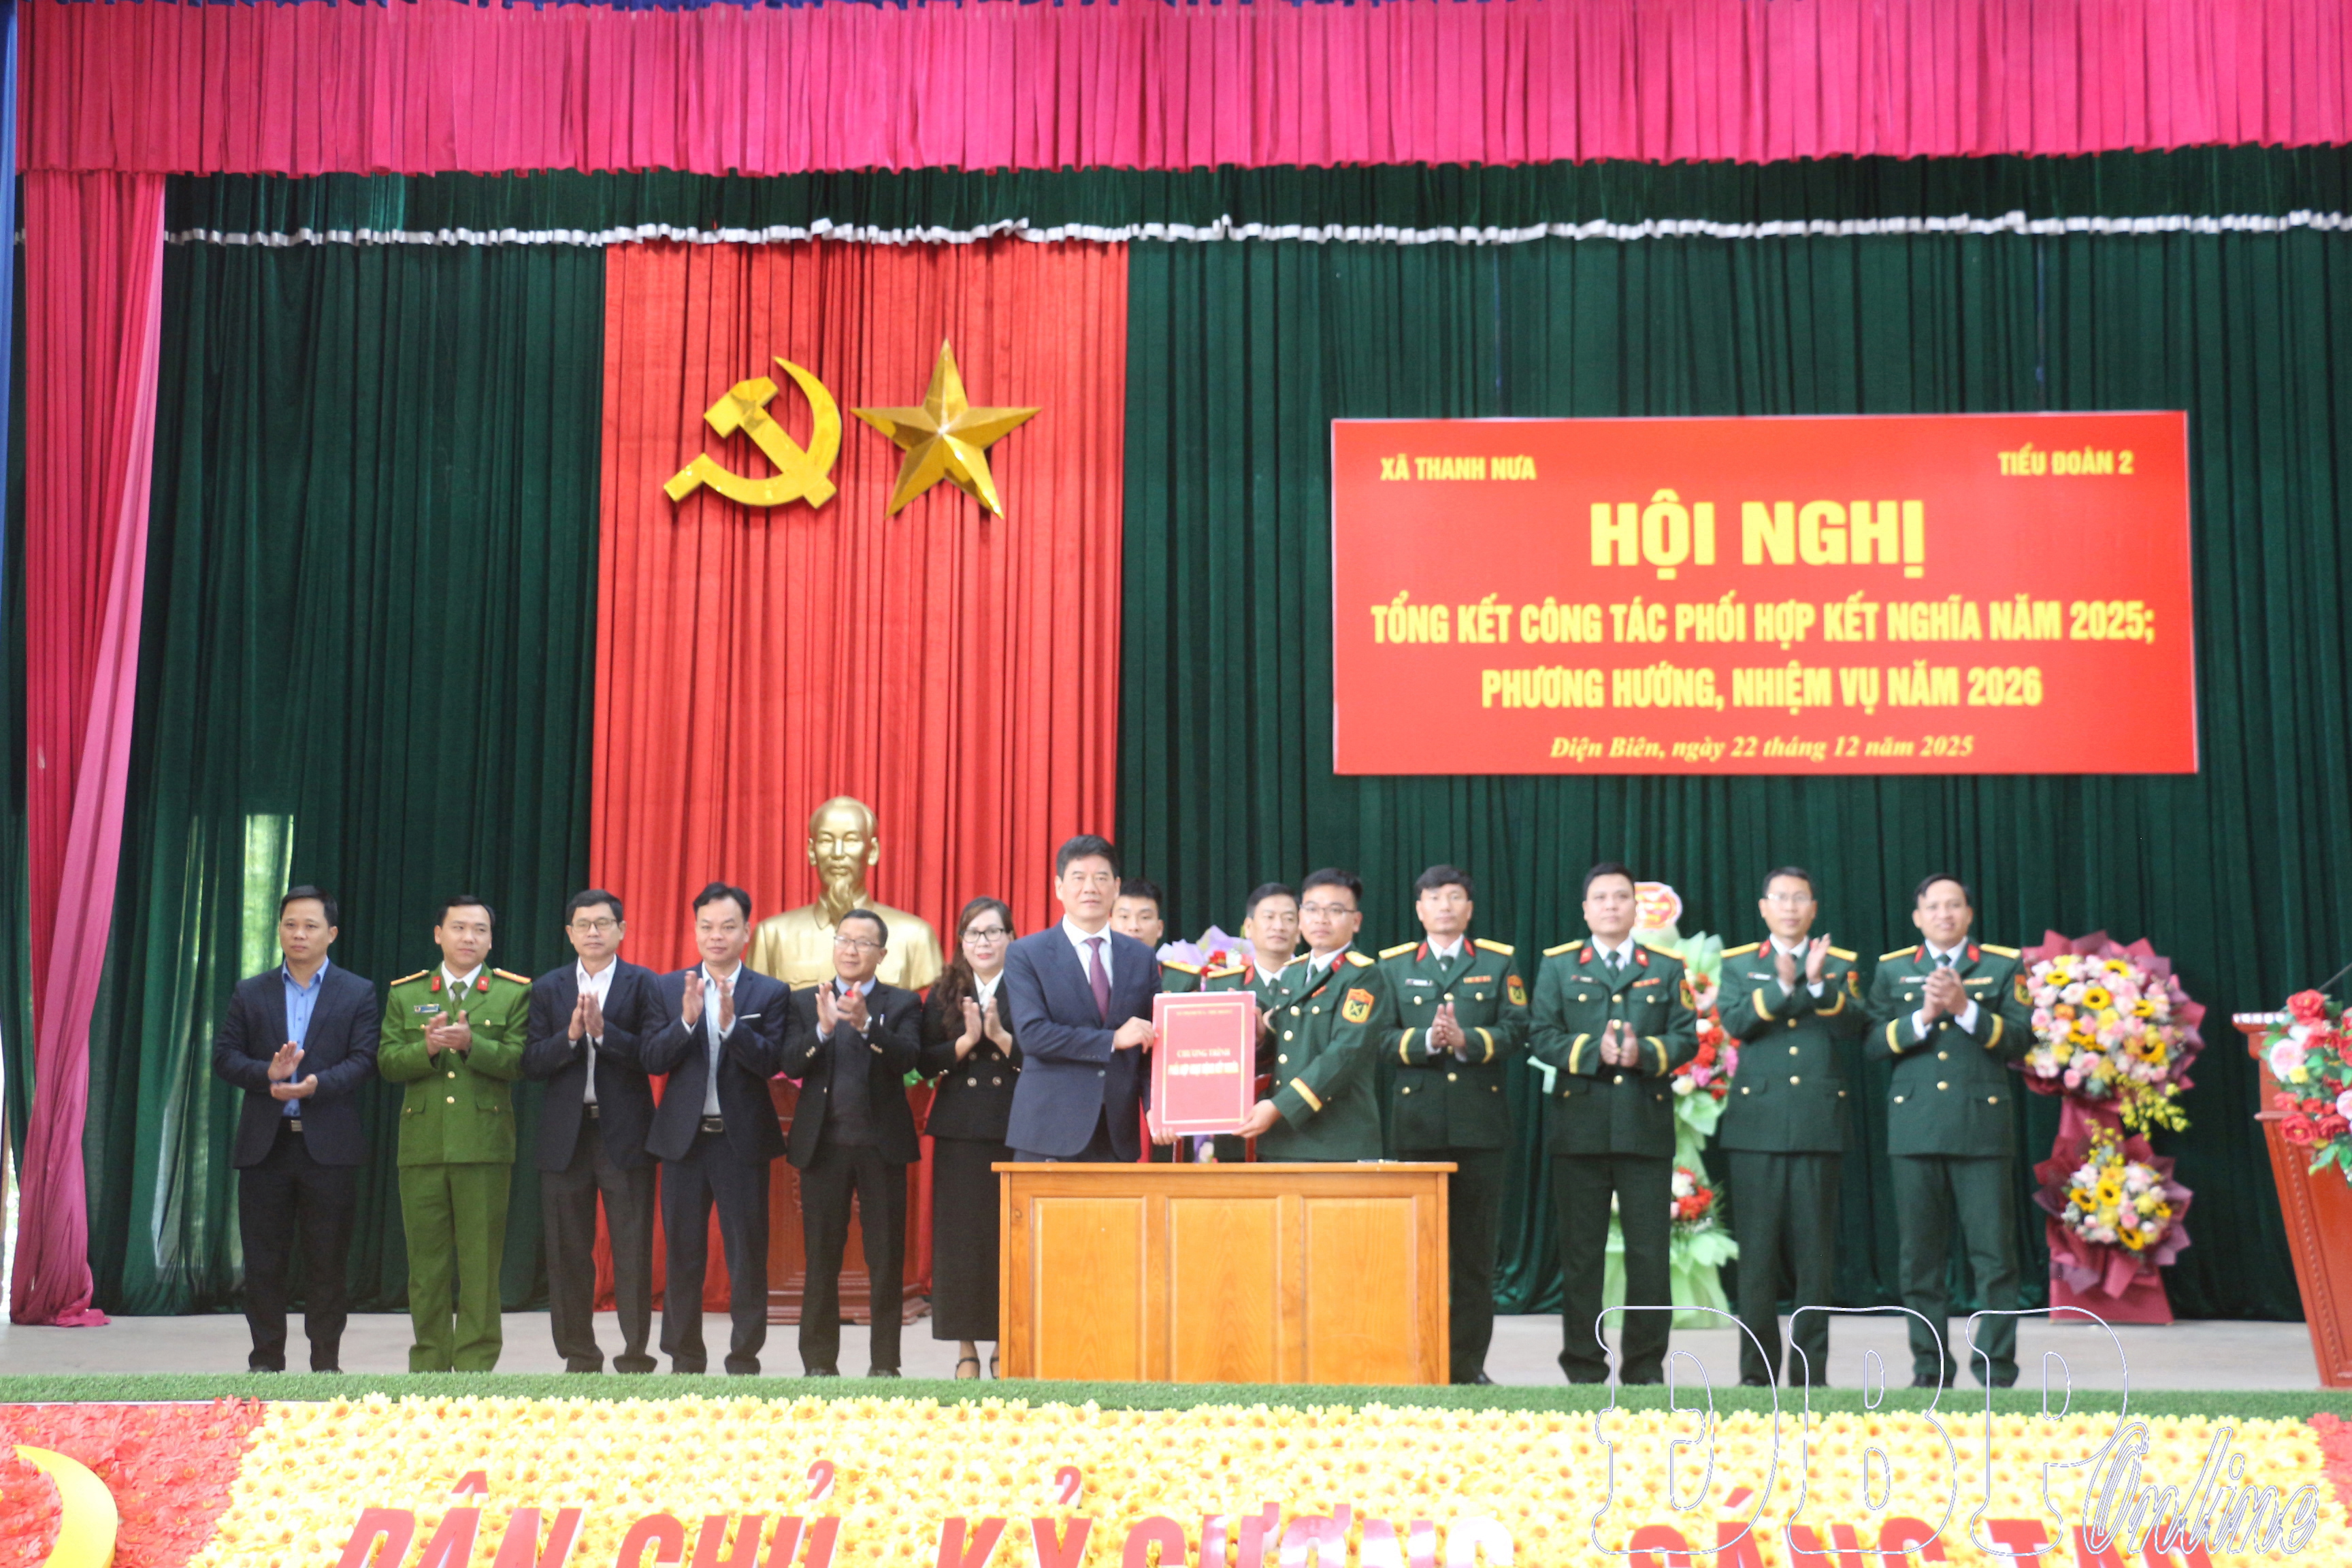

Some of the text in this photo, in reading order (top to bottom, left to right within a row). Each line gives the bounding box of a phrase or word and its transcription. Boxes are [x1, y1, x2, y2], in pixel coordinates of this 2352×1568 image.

[1379, 453, 1537, 481] XÃ THANH NƯA
[1997, 442, 2134, 476] TIỂU ĐOÀN 2
[1590, 488, 1925, 581] HỘI NGHỊ
[1370, 589, 2155, 651] TỔNG KẾT CÔNG TÁC PHỐI HỢP KẾT NGHĨA NĂM 2025;
[1482, 659, 2043, 716] PHƯƠNG HƯỚNG, NHIỆM VỤ NĂM 2026
[1608, 736, 1666, 760] Biên,
[1671, 736, 1726, 763] ngày
[1731, 736, 1759, 757] 22
[1762, 735, 1828, 763] tháng
[1834, 735, 1861, 757] 12
[1864, 736, 1915, 757] năm
[1920, 735, 1974, 757] 2025
